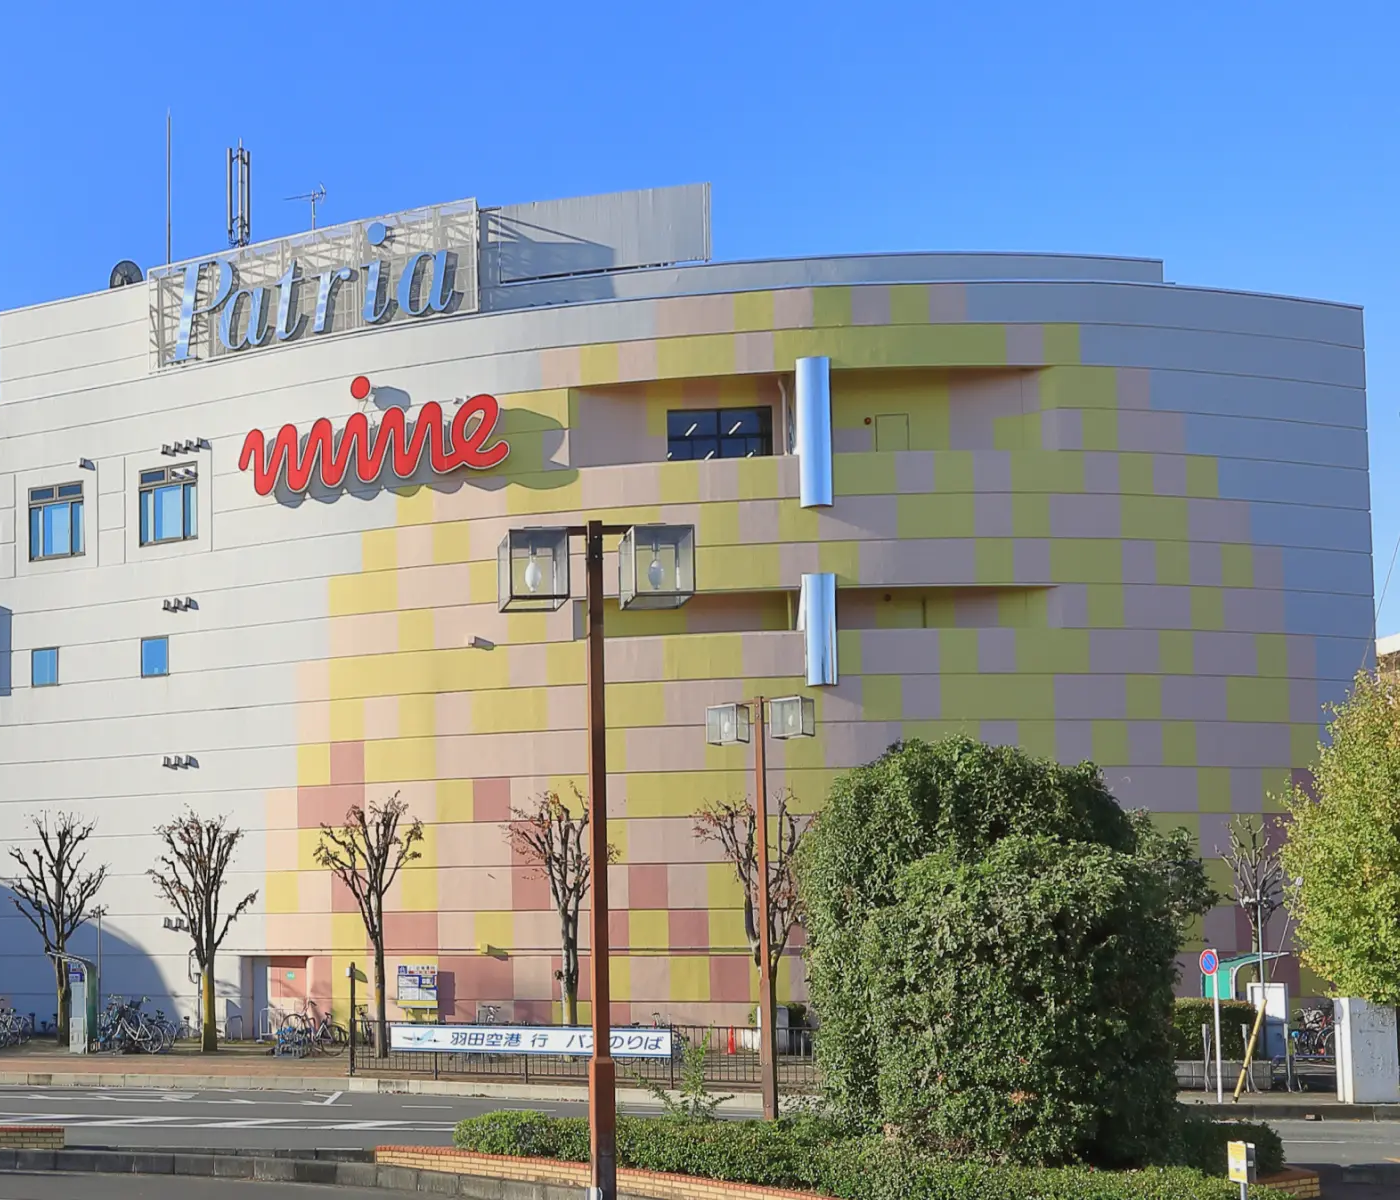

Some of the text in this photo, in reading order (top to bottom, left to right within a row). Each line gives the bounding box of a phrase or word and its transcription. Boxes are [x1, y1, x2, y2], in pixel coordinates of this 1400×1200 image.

[165, 222, 460, 363] Patria
[238, 375, 509, 496] mine
[450, 1032, 522, 1047] 羽田空港
[530, 1033, 549, 1048] 行
